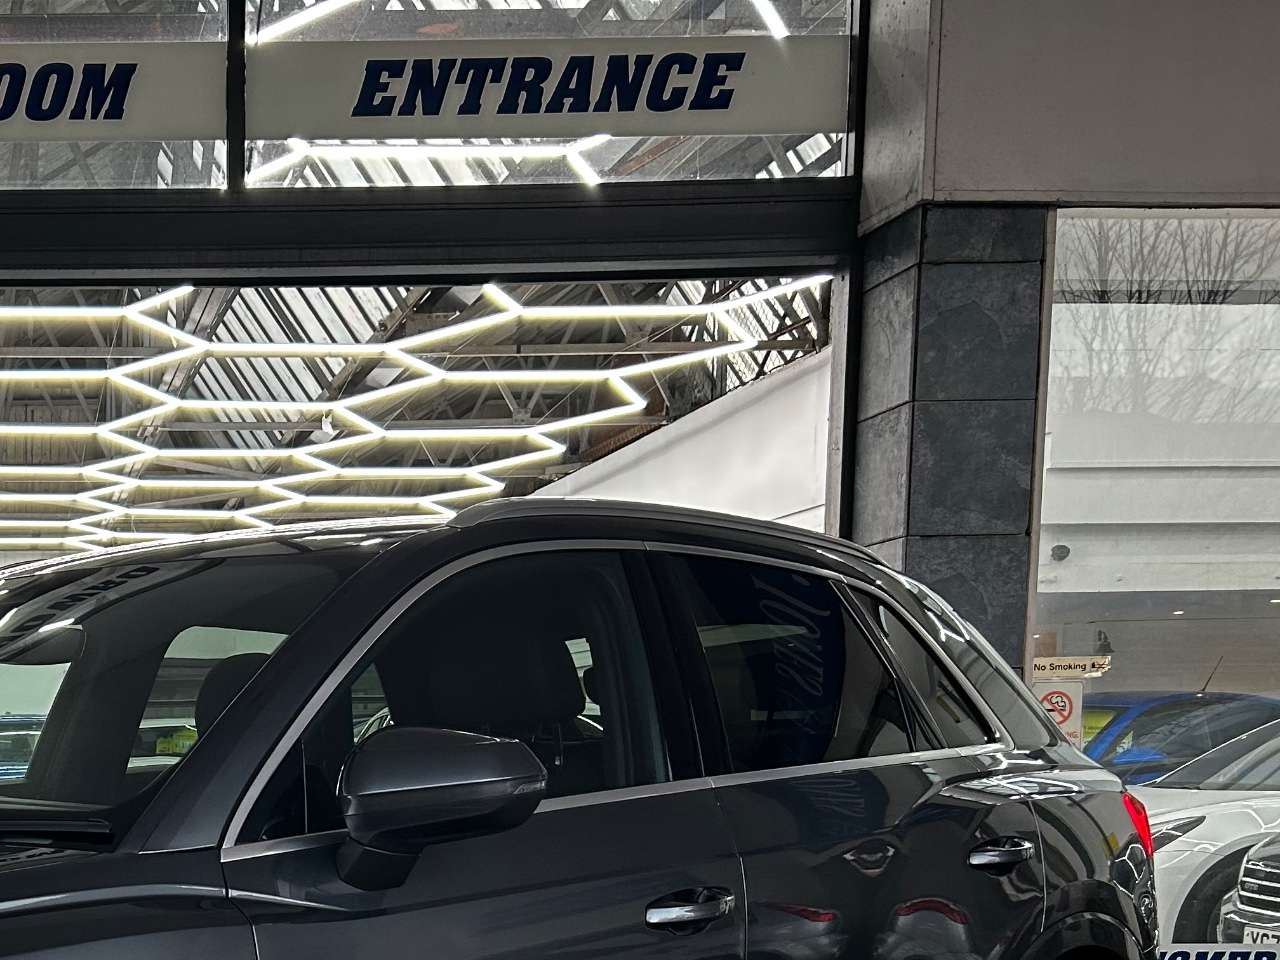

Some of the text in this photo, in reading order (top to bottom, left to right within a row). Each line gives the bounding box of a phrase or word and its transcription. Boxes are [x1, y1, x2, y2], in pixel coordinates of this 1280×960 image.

[351, 51, 746, 118] ENTRANCE
[1033, 662, 1087, 672] No Smoking
